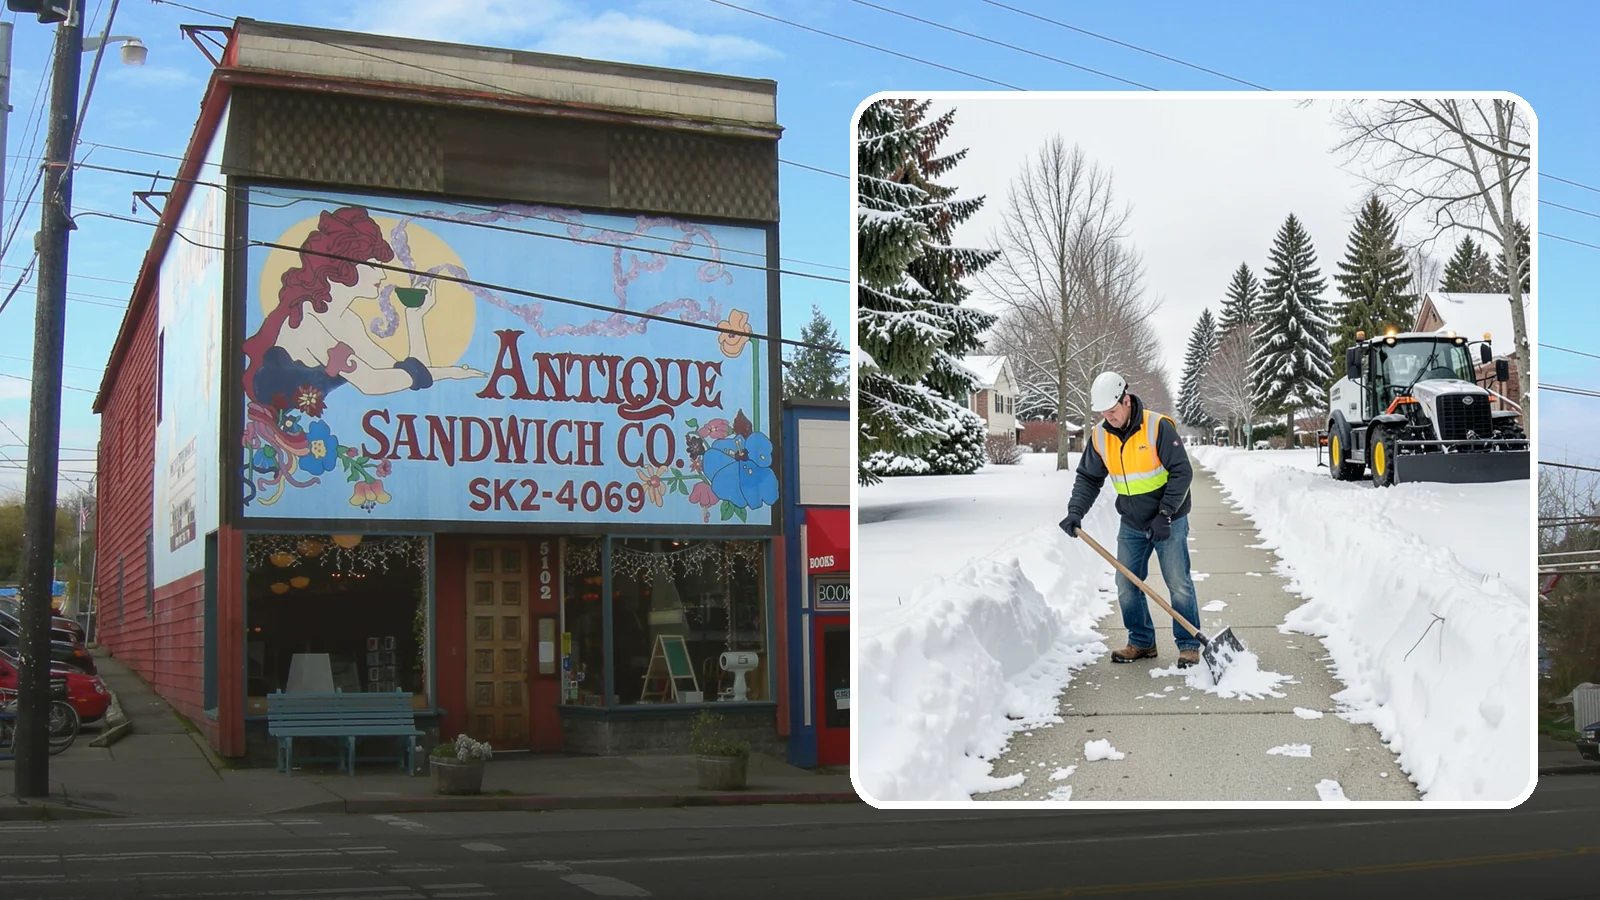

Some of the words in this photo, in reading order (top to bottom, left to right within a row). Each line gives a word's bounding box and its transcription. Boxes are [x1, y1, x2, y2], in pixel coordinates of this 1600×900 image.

[476, 329, 723, 420] ANTIQUE
[361, 408, 605, 467] SANDWICH
[617, 422, 685, 469] CO.
[468, 477, 645, 513] SK2-4069
[540, 541, 552, 600] 5102
[809, 554, 835, 569] BOOKS
